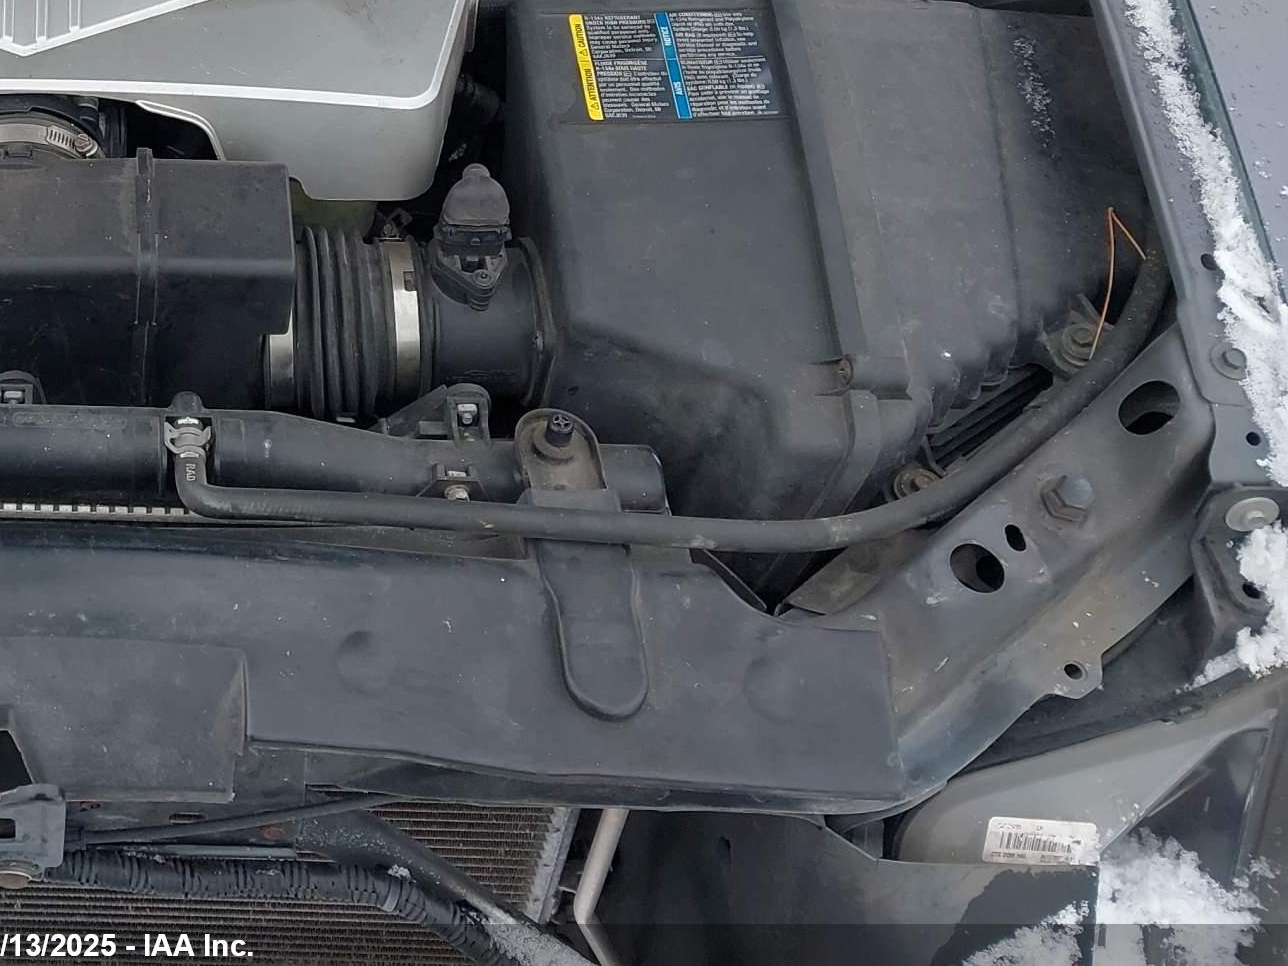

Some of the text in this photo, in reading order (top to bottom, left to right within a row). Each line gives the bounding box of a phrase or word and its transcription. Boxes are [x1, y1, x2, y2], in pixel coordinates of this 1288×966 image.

[575, 23, 585, 48] CAUTION
[660, 26, 672, 46] NOTICE
[584, 68, 598, 101] ATTENTION
[673, 81, 683, 95] AVIS
[185, 463, 196, 482] RAD
